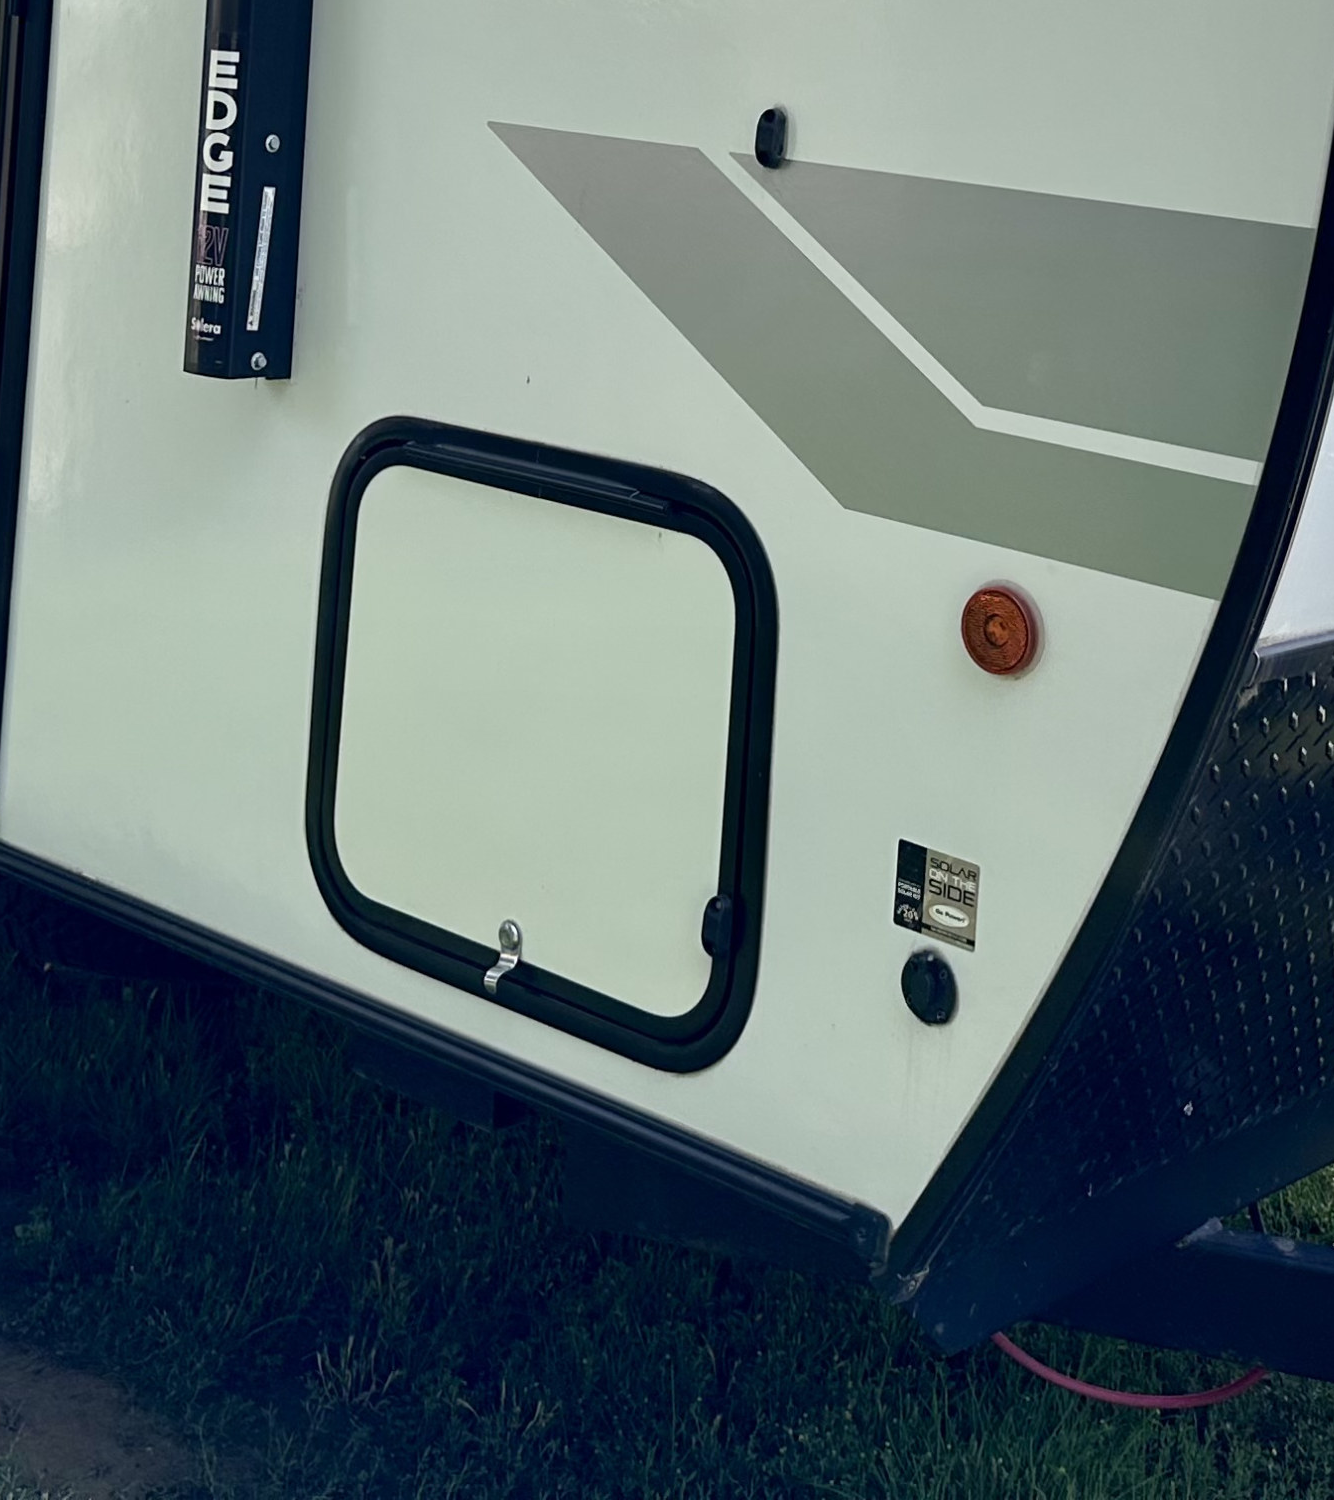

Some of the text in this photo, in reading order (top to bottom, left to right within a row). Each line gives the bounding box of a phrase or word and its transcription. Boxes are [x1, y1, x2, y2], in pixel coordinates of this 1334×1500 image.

[200, 49, 240, 214] EDGE
[195, 264, 226, 287] POWER
[193, 285, 225, 304] AWNING
[191, 316, 222, 335] Solera
[929, 868, 948, 882] ON
[951, 875, 977, 892] THE
[930, 857, 977, 881] SOLAR
[928, 879, 976, 907] SIDE
